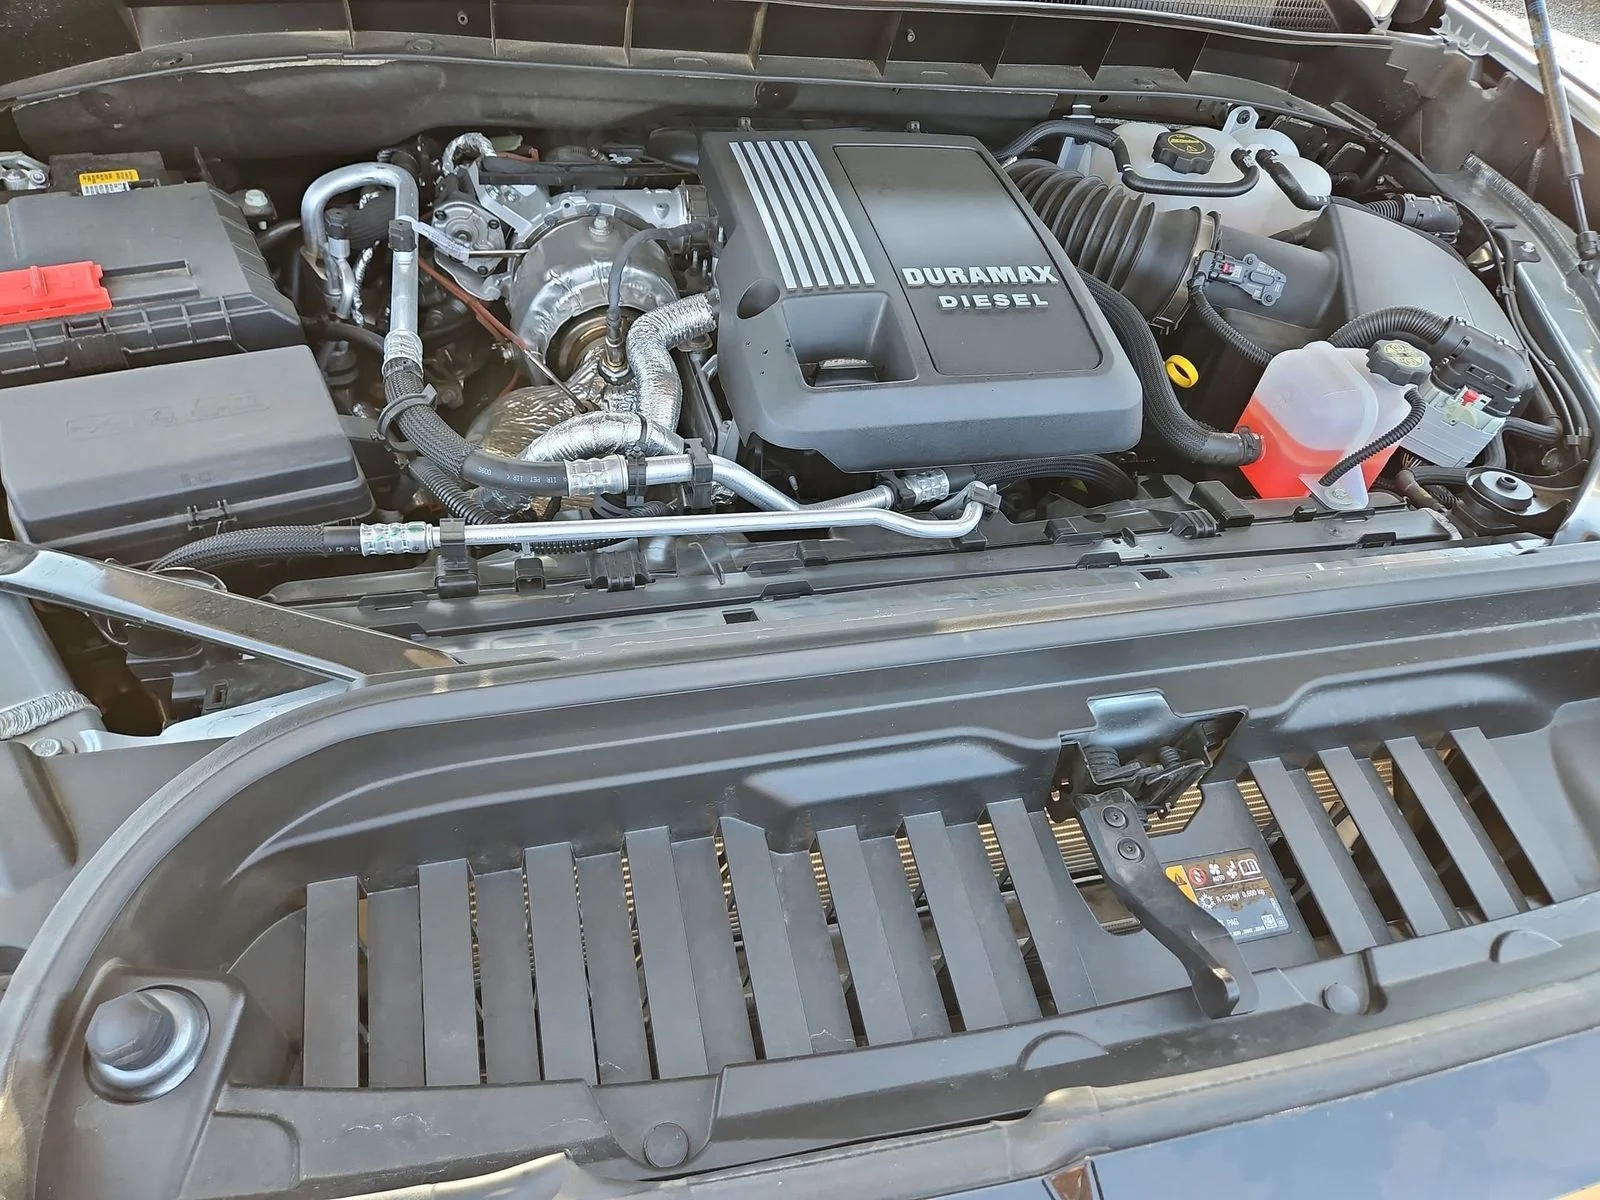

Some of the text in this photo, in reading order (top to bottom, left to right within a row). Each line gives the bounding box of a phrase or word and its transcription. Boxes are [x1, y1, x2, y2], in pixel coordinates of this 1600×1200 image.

[901, 265, 1059, 286] DURAMAX
[938, 293, 1049, 309] DIESEL
[823, 358, 867, 367] ACDelco
[1216, 892, 1240, 904] R-1234yf
[1257, 888, 1265, 896] kg
[1226, 918, 1239, 927] PAG
